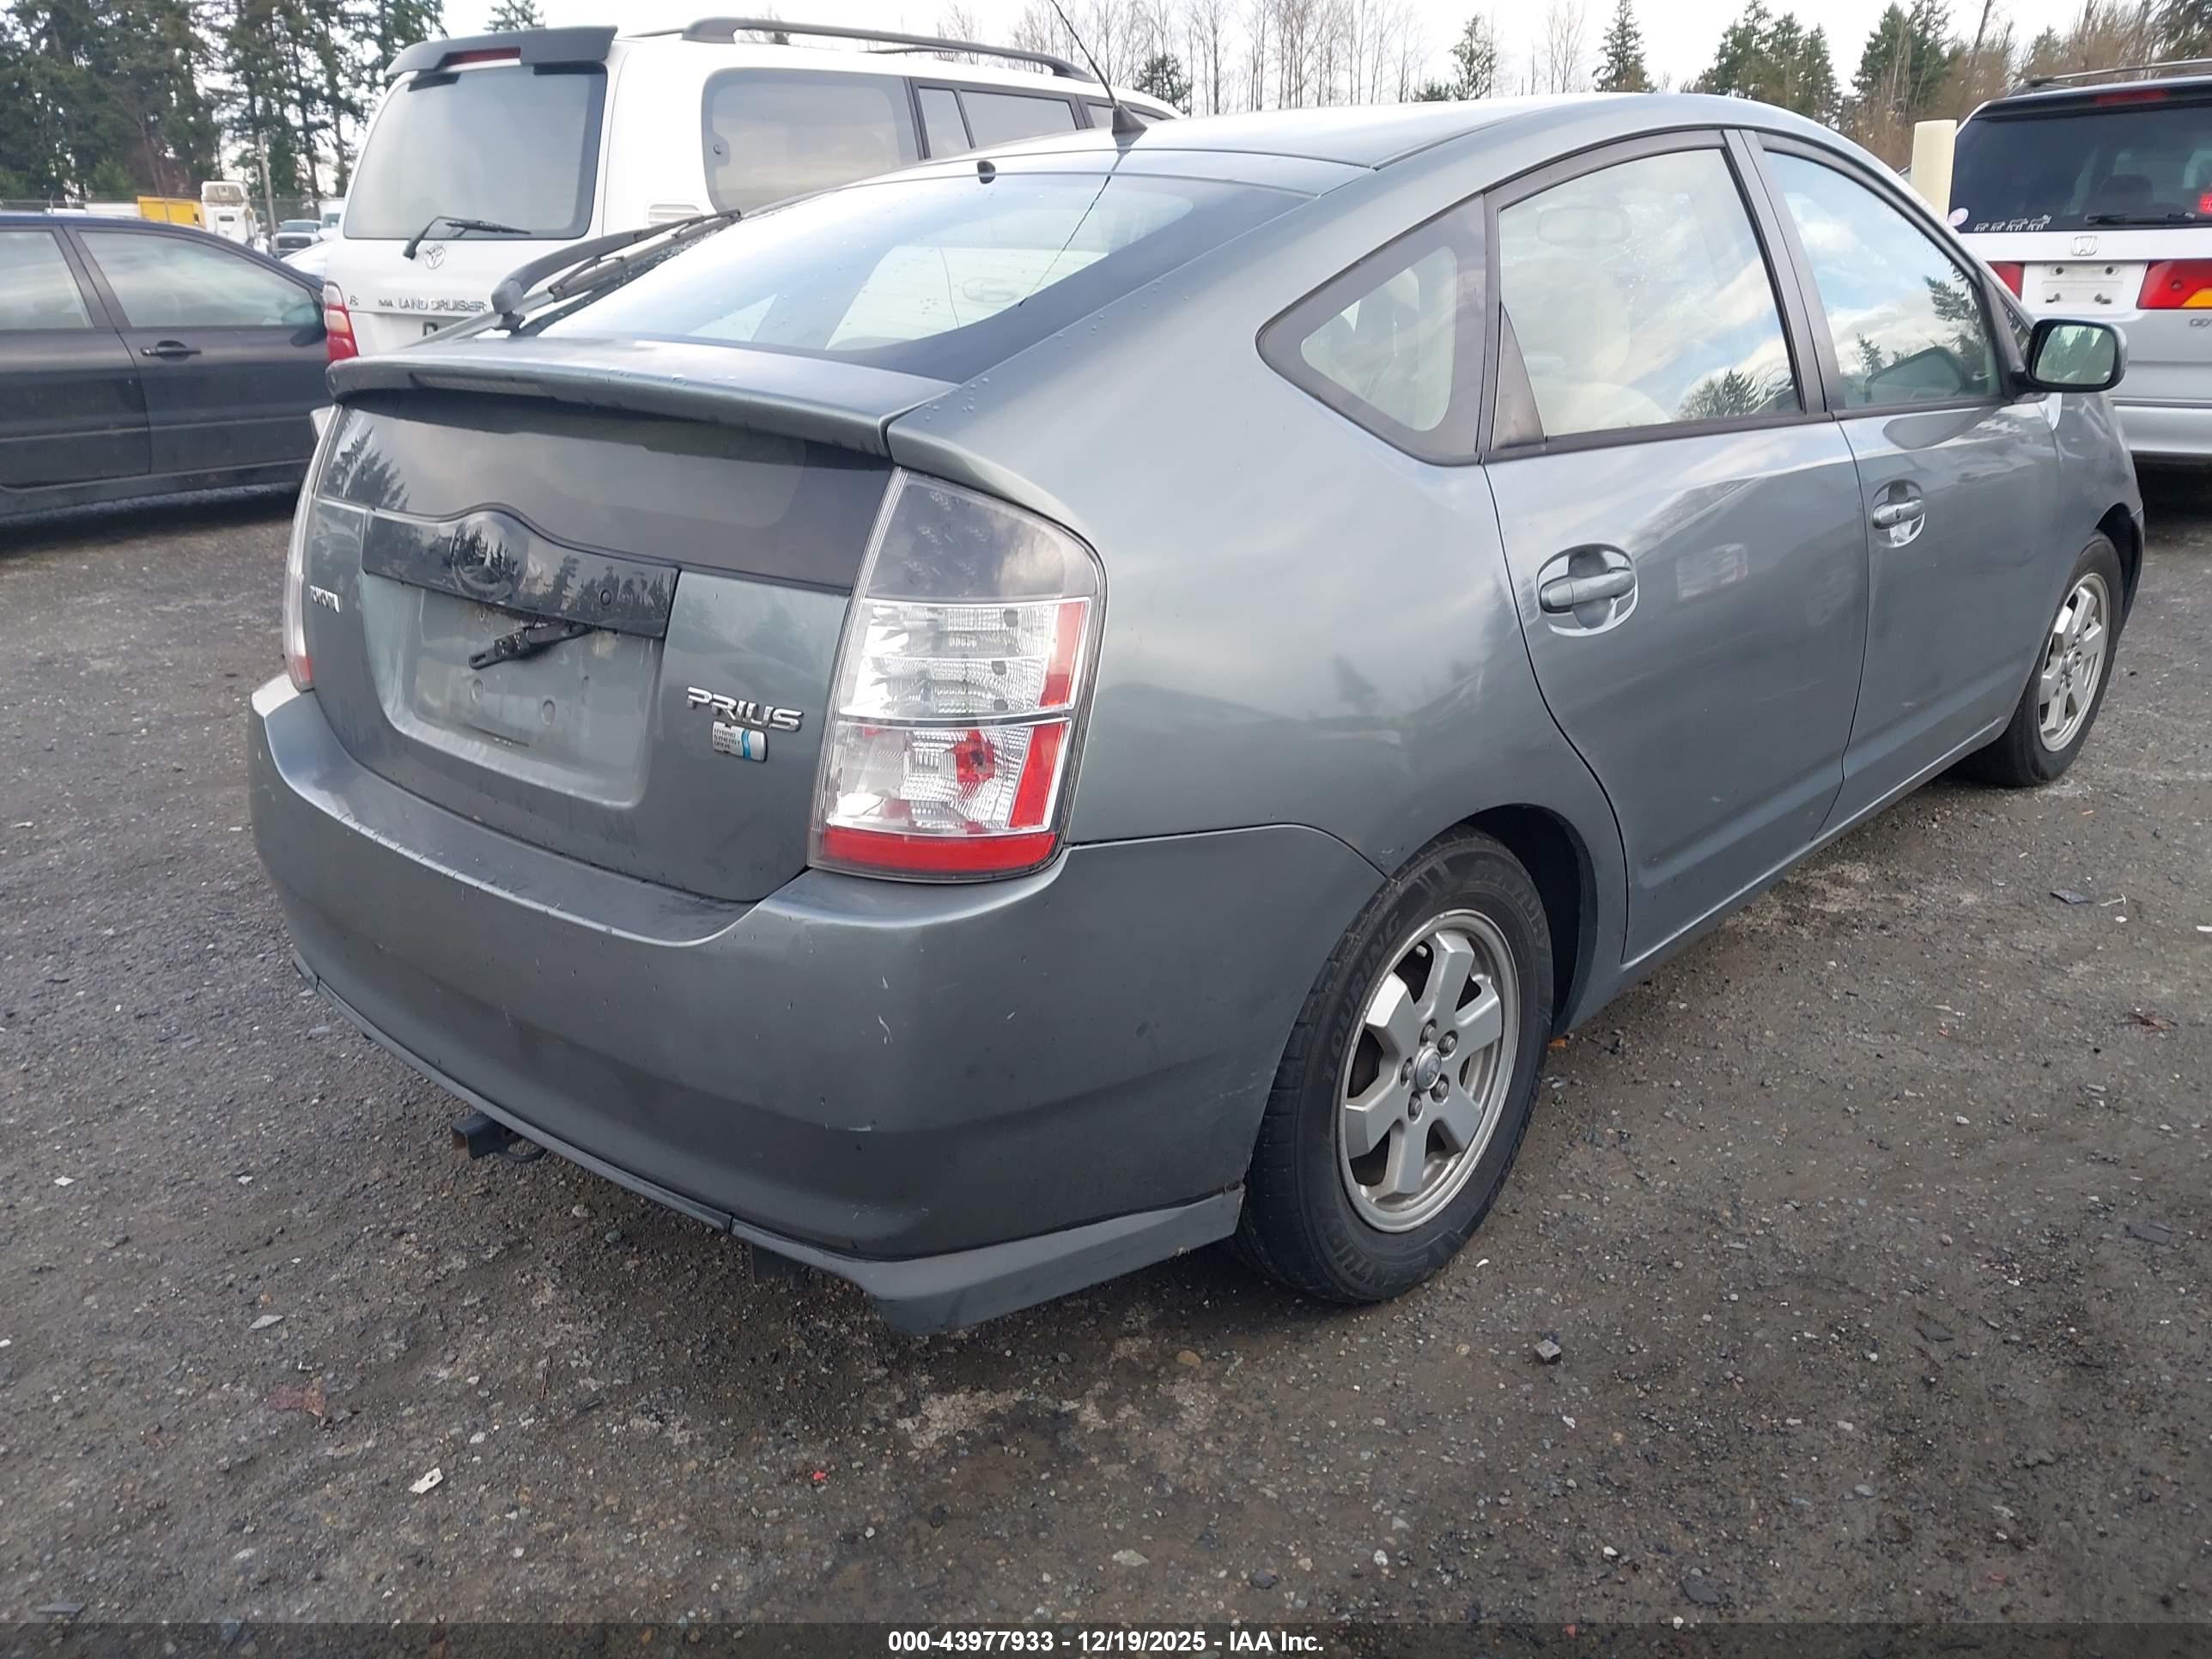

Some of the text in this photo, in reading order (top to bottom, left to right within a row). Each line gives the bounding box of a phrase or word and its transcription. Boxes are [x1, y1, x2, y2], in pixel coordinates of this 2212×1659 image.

[398, 297, 488, 313] LAND CRUISER
[687, 686, 804, 732] PRIUS
